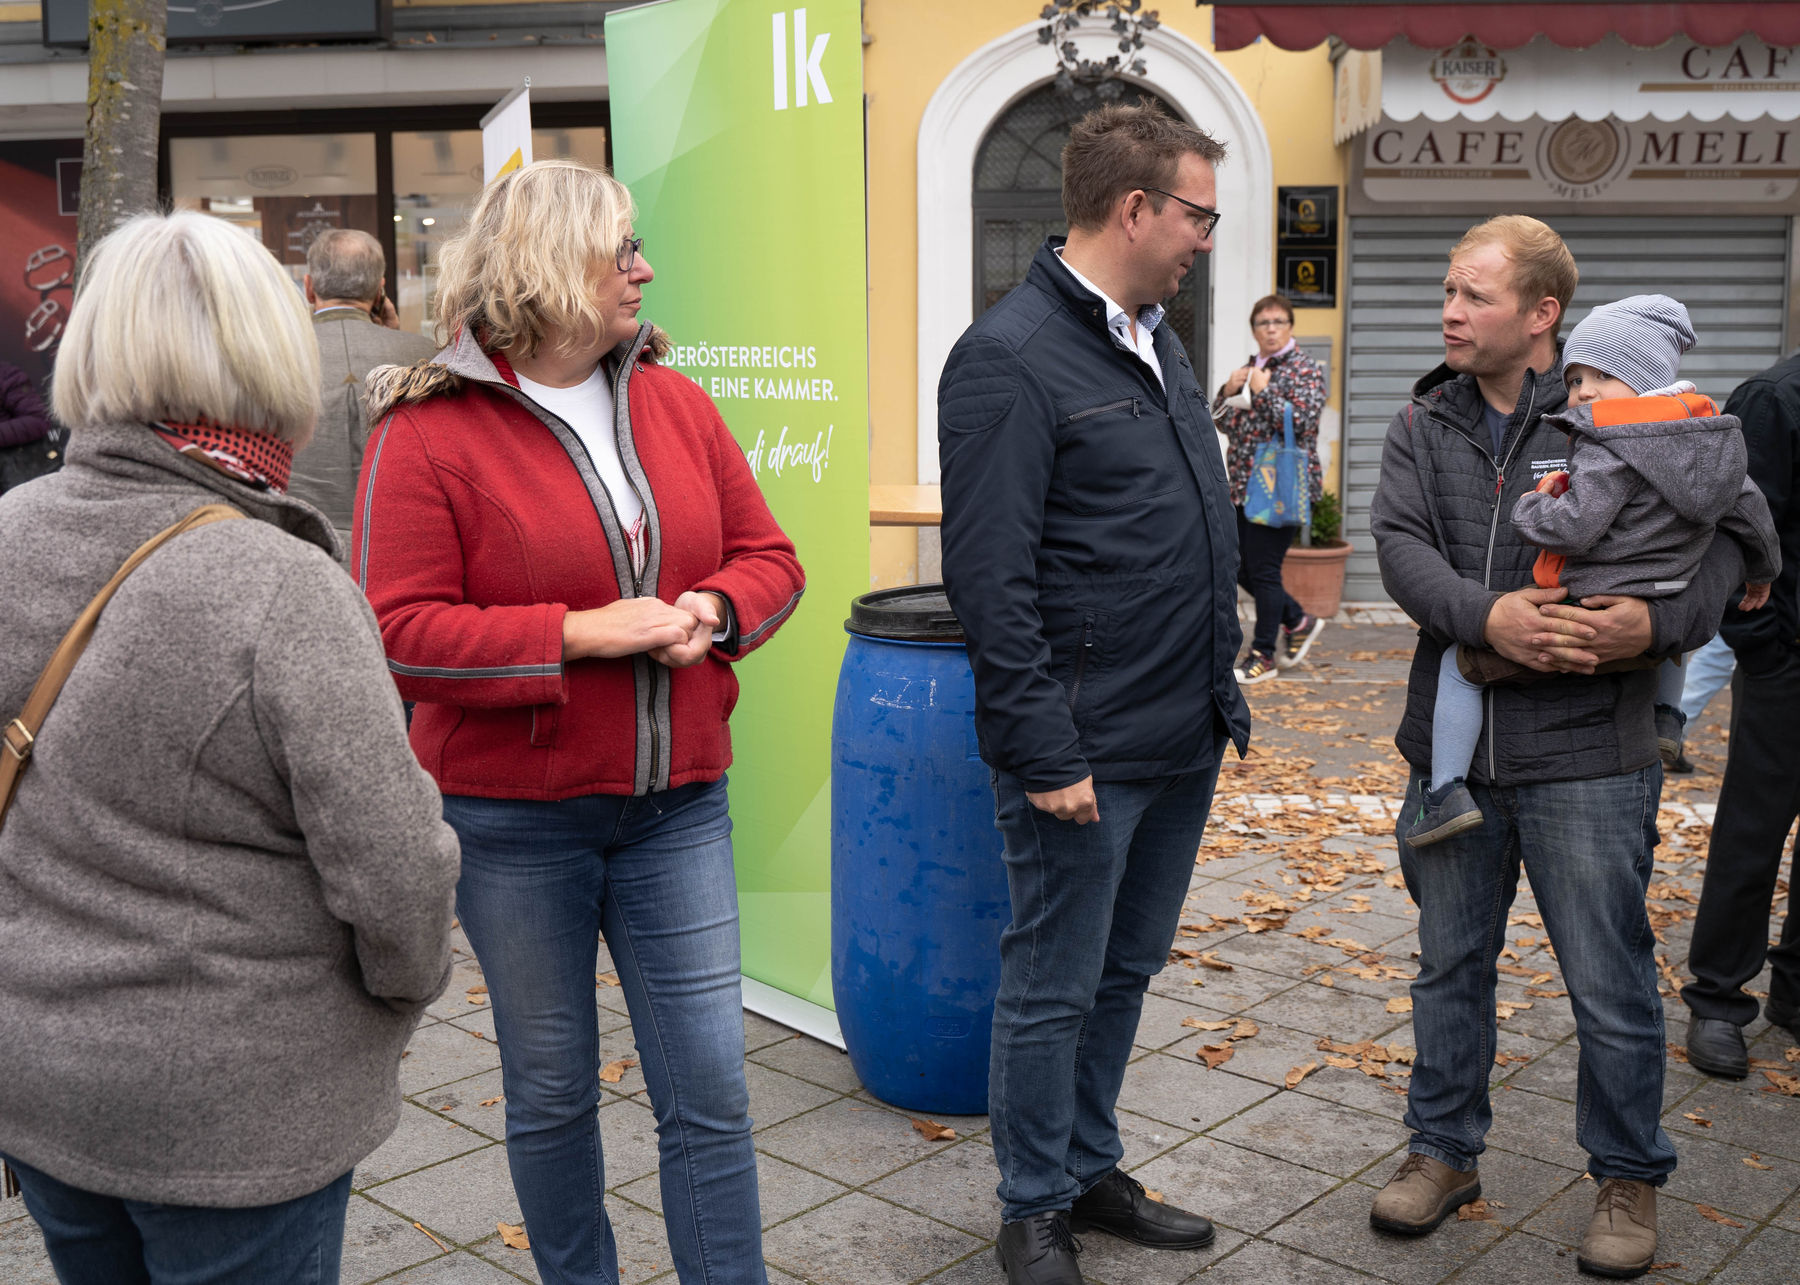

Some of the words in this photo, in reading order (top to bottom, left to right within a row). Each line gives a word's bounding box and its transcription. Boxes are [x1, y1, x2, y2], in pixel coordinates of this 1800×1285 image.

[772, 8, 834, 111] lk
[1442, 60, 1497, 76] KAISER
[1372, 129, 1525, 165] CAFE
[1637, 129, 1791, 165] MELI
[657, 341, 817, 368] DERÖSTERREICHS
[711, 376, 750, 398] EINE
[754, 378, 839, 401] KAMMER.
[768, 424, 834, 483] drauf!
